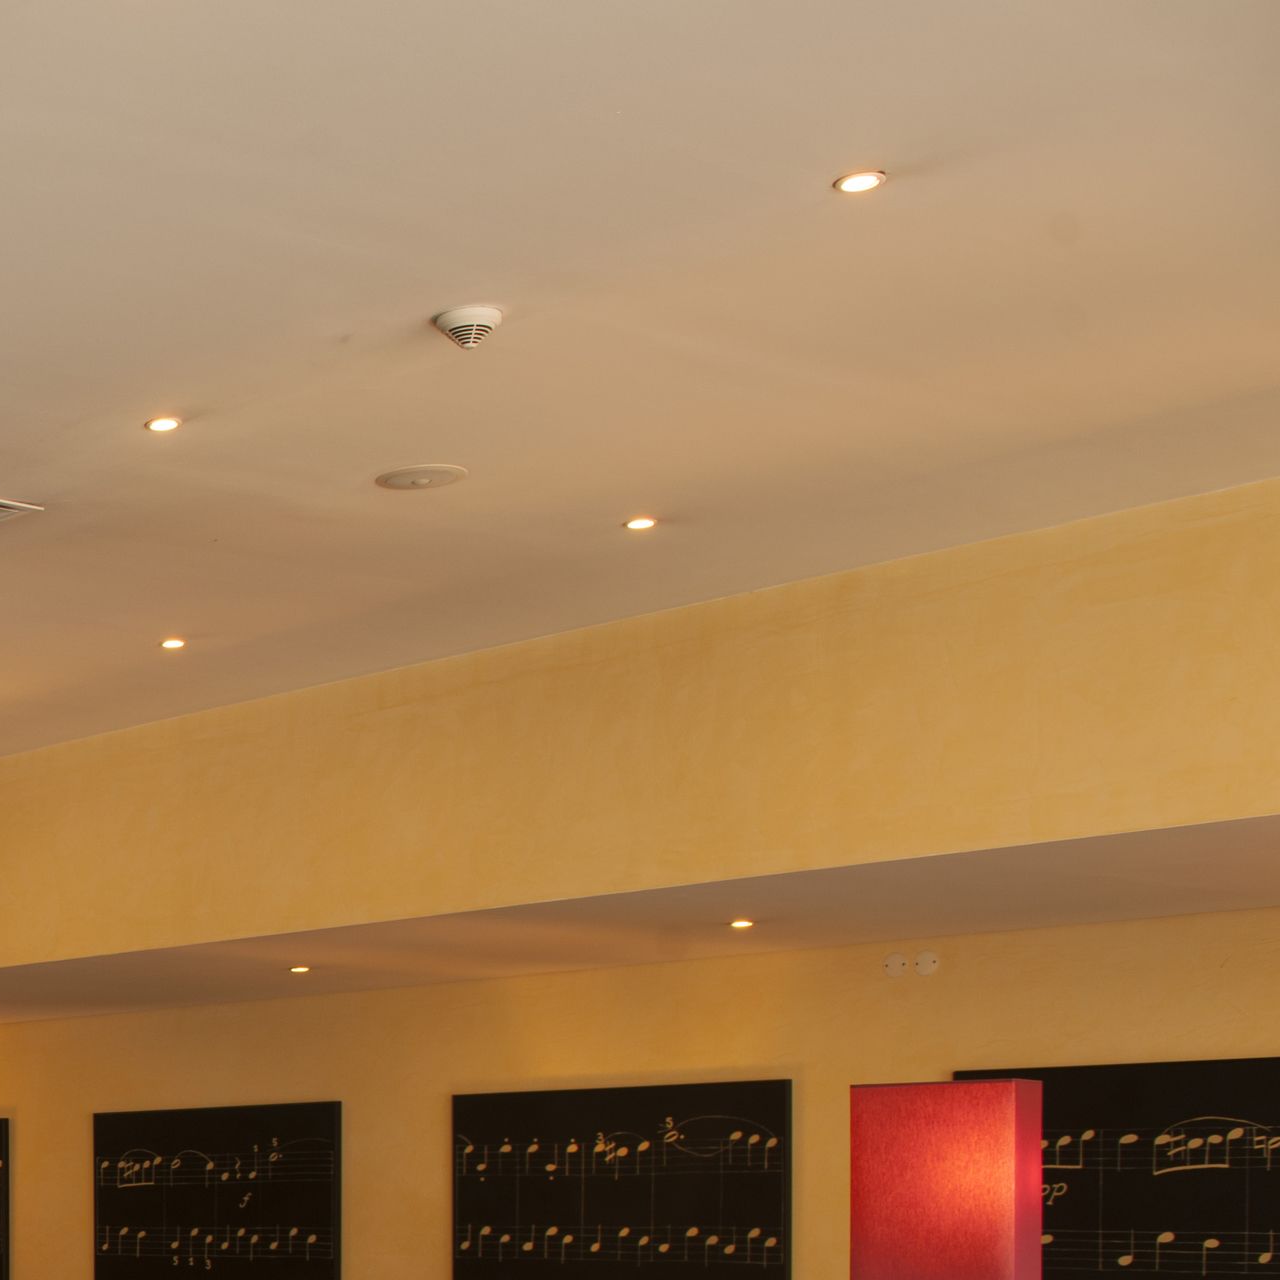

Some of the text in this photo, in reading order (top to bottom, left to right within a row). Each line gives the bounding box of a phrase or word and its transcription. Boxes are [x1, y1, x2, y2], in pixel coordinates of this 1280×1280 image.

[665, 1117, 674, 1128] 5
[596, 1132, 604, 1143] 3
[205, 1259, 212, 1270] 3
